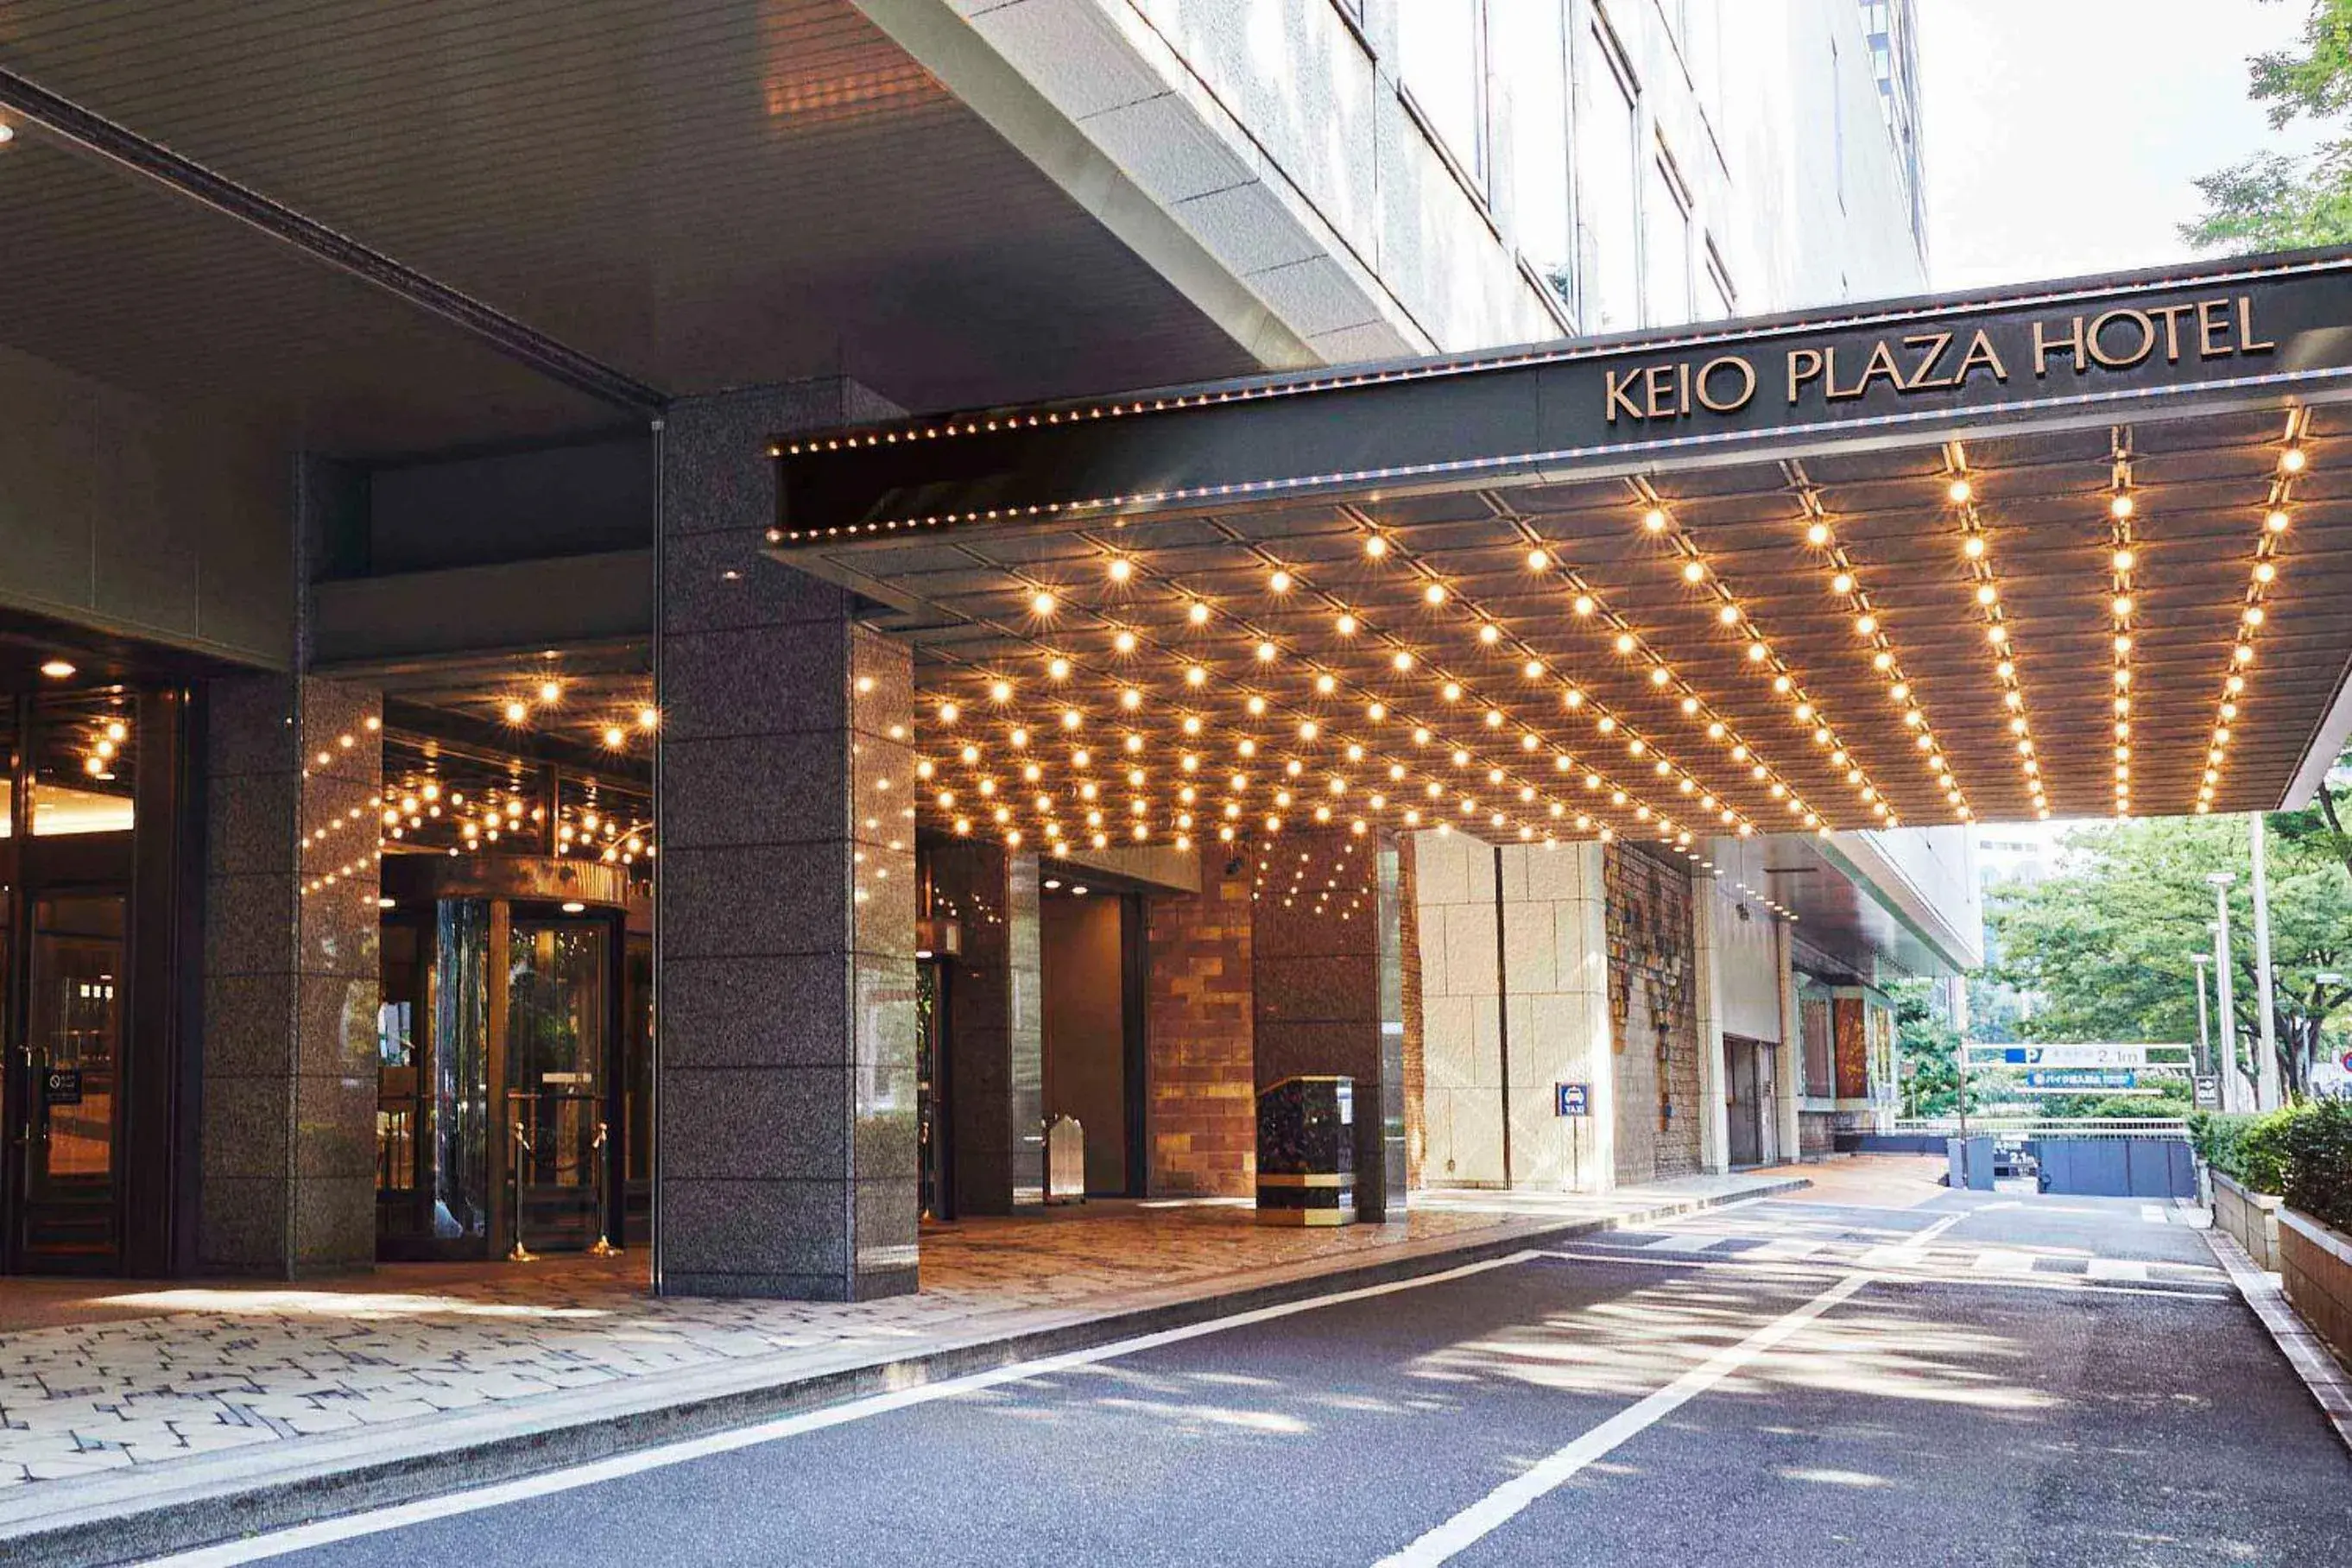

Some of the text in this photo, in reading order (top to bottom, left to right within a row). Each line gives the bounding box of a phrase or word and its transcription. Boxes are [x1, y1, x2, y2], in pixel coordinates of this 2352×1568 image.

[1606, 296, 2276, 422] KEIO PLAZA HOTEL
[1565, 1104, 1584, 1114] TAXI
